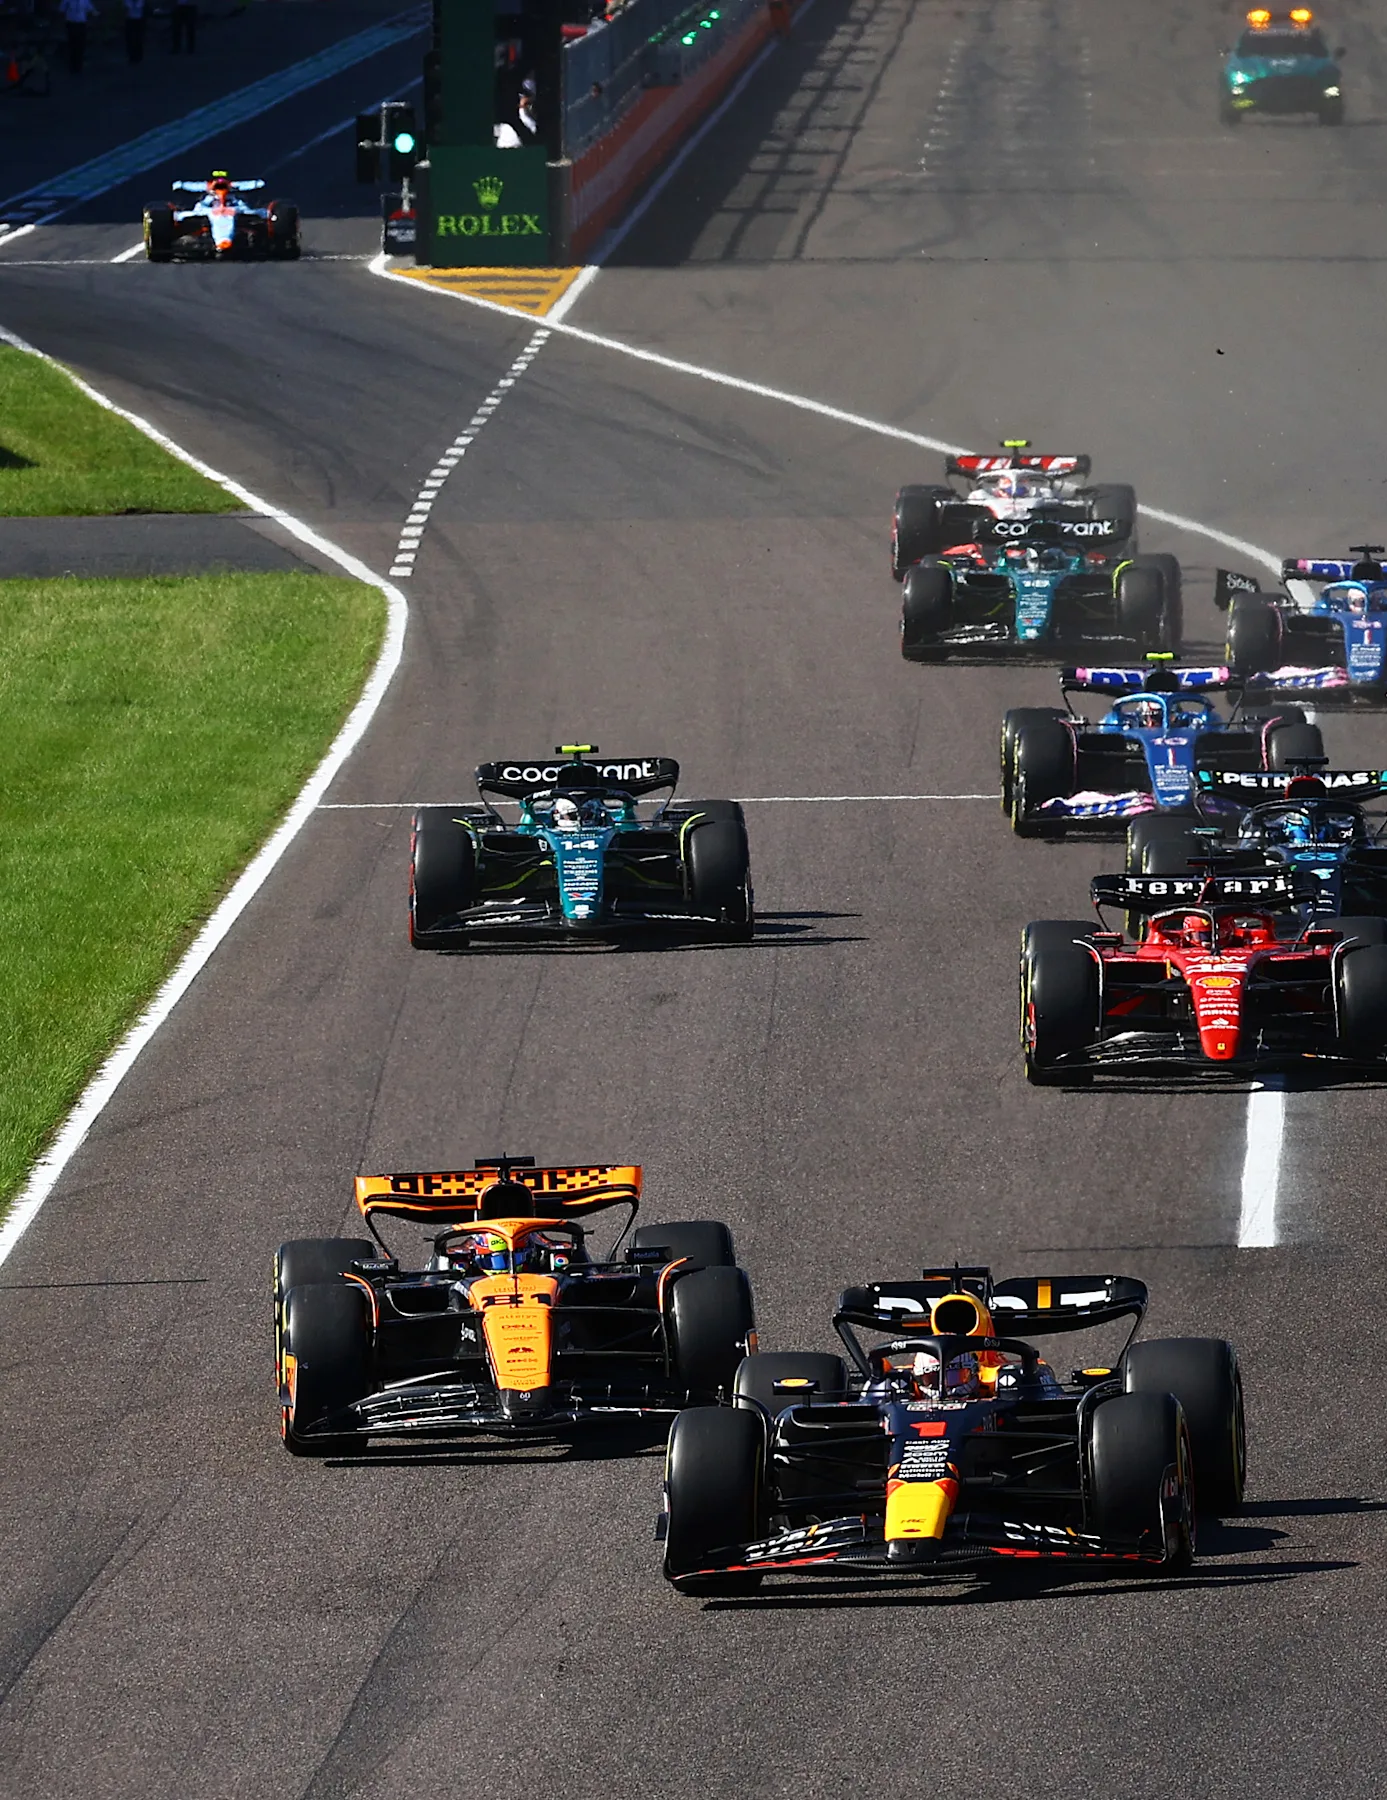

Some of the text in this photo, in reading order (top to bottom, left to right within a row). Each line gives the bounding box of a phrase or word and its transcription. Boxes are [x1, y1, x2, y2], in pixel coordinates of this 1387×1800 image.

[436, 214, 543, 237] ROLEX
[1222, 772, 1371, 789] PETRNAS
[560, 840, 599, 851] 14
[909, 1421, 947, 1437] 1
